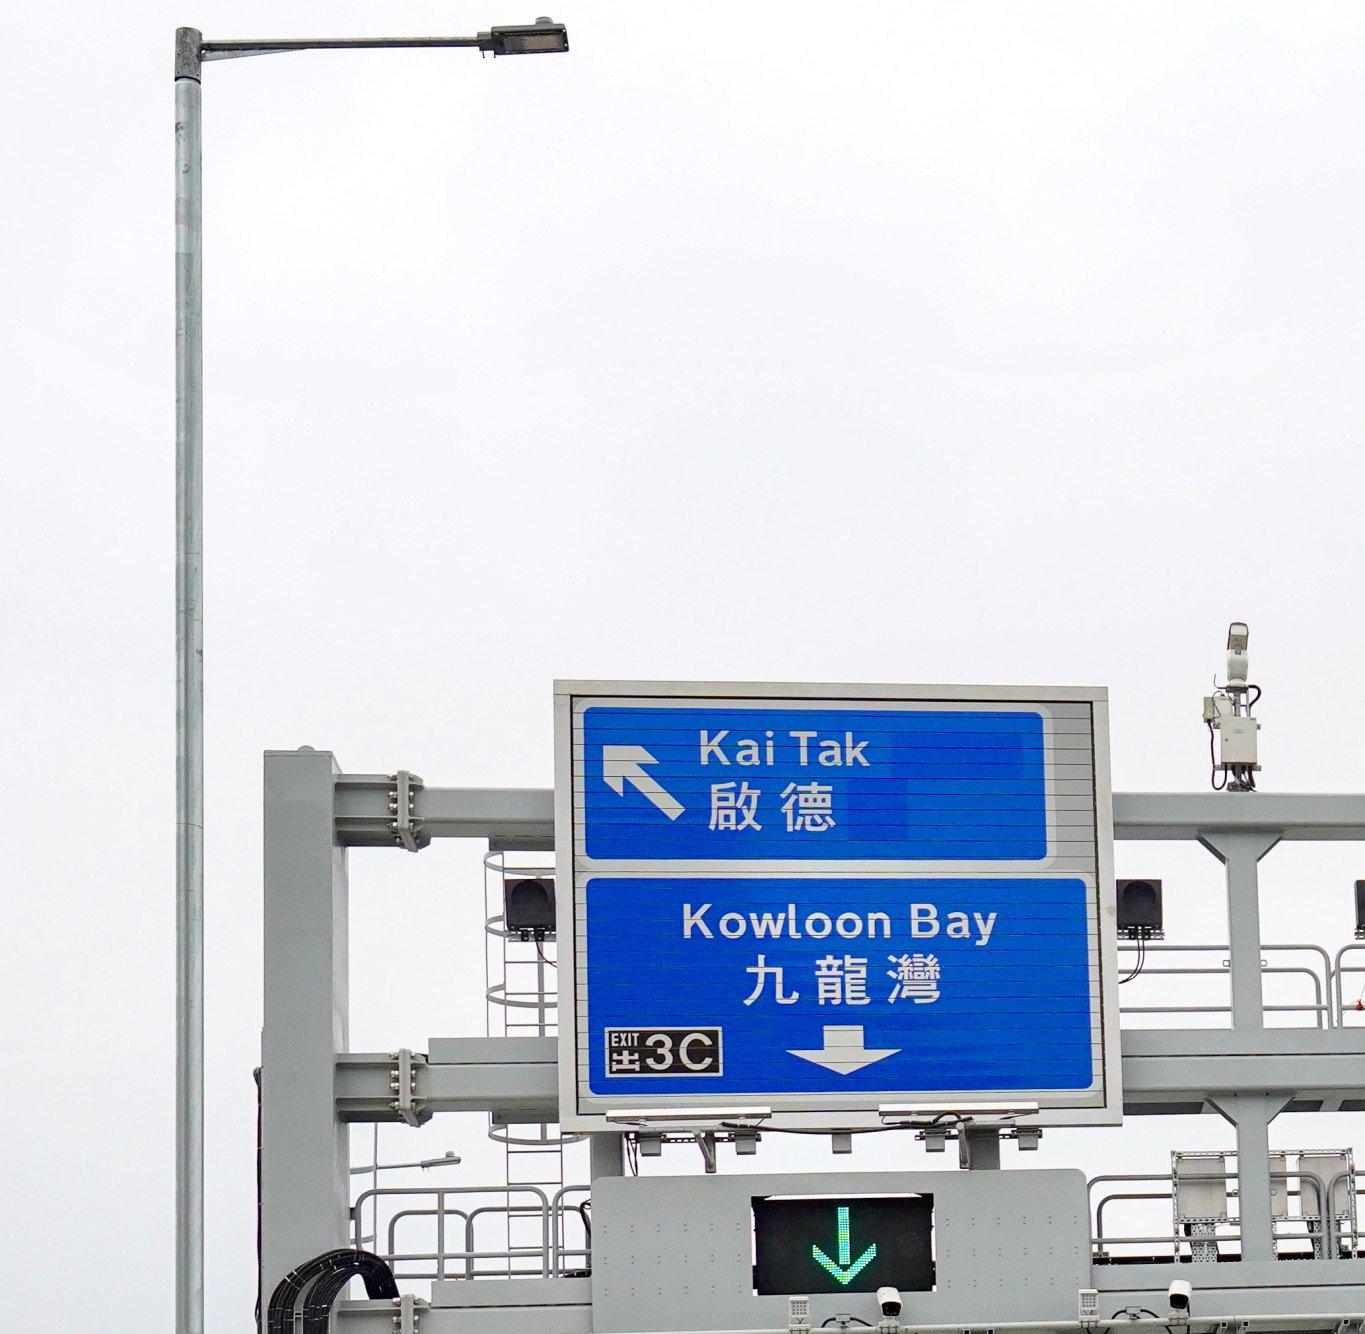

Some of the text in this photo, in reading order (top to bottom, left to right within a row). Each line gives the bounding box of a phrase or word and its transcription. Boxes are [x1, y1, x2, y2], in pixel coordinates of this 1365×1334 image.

[699, 729, 871, 768] Kai Tak
[708, 781, 837, 833] 啟德
[682, 903, 998, 946] Kowloon Bay
[742, 953, 941, 1006] 九龍灣
[611, 1033, 640, 1047] EXIT
[645, 1032, 713, 1071] 3C
[611, 1050, 640, 1072] 出
